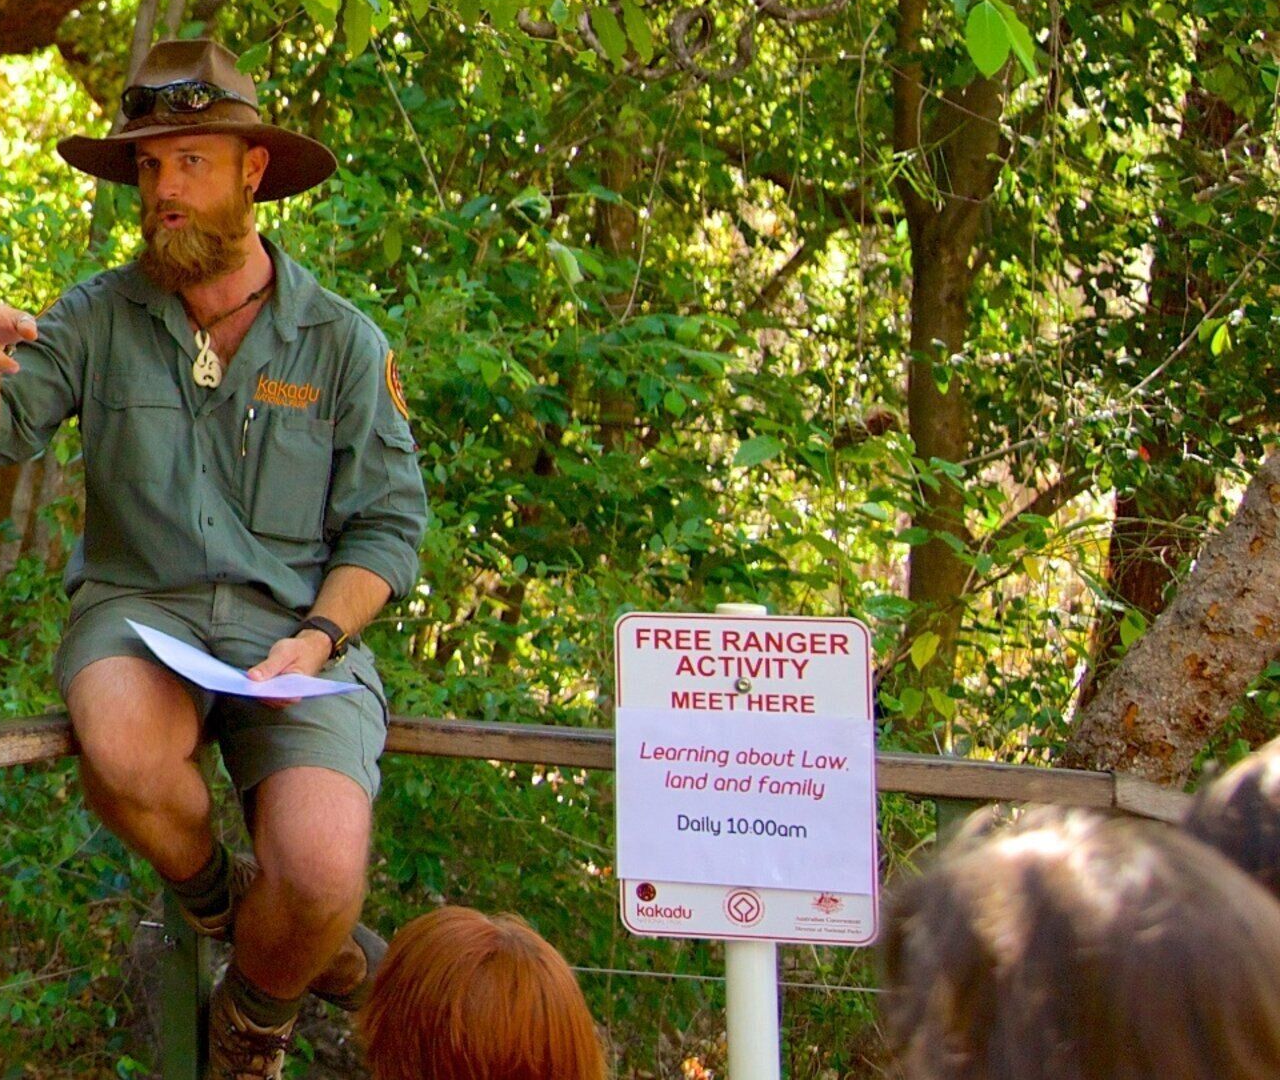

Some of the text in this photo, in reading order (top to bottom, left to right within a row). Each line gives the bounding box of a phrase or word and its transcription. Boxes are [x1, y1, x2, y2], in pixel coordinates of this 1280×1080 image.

[256, 373, 320, 402] kakadu
[635, 628, 850, 654] FREE RANGER
[676, 656, 809, 679] ACTIVITY
[671, 691, 815, 713] MEET HERE
[639, 742, 730, 768] Learning
[736, 748, 795, 767] about
[665, 771, 825, 801] land and family
[677, 814, 807, 839] Daily 10:00am
[636, 902, 692, 920] kakadu
